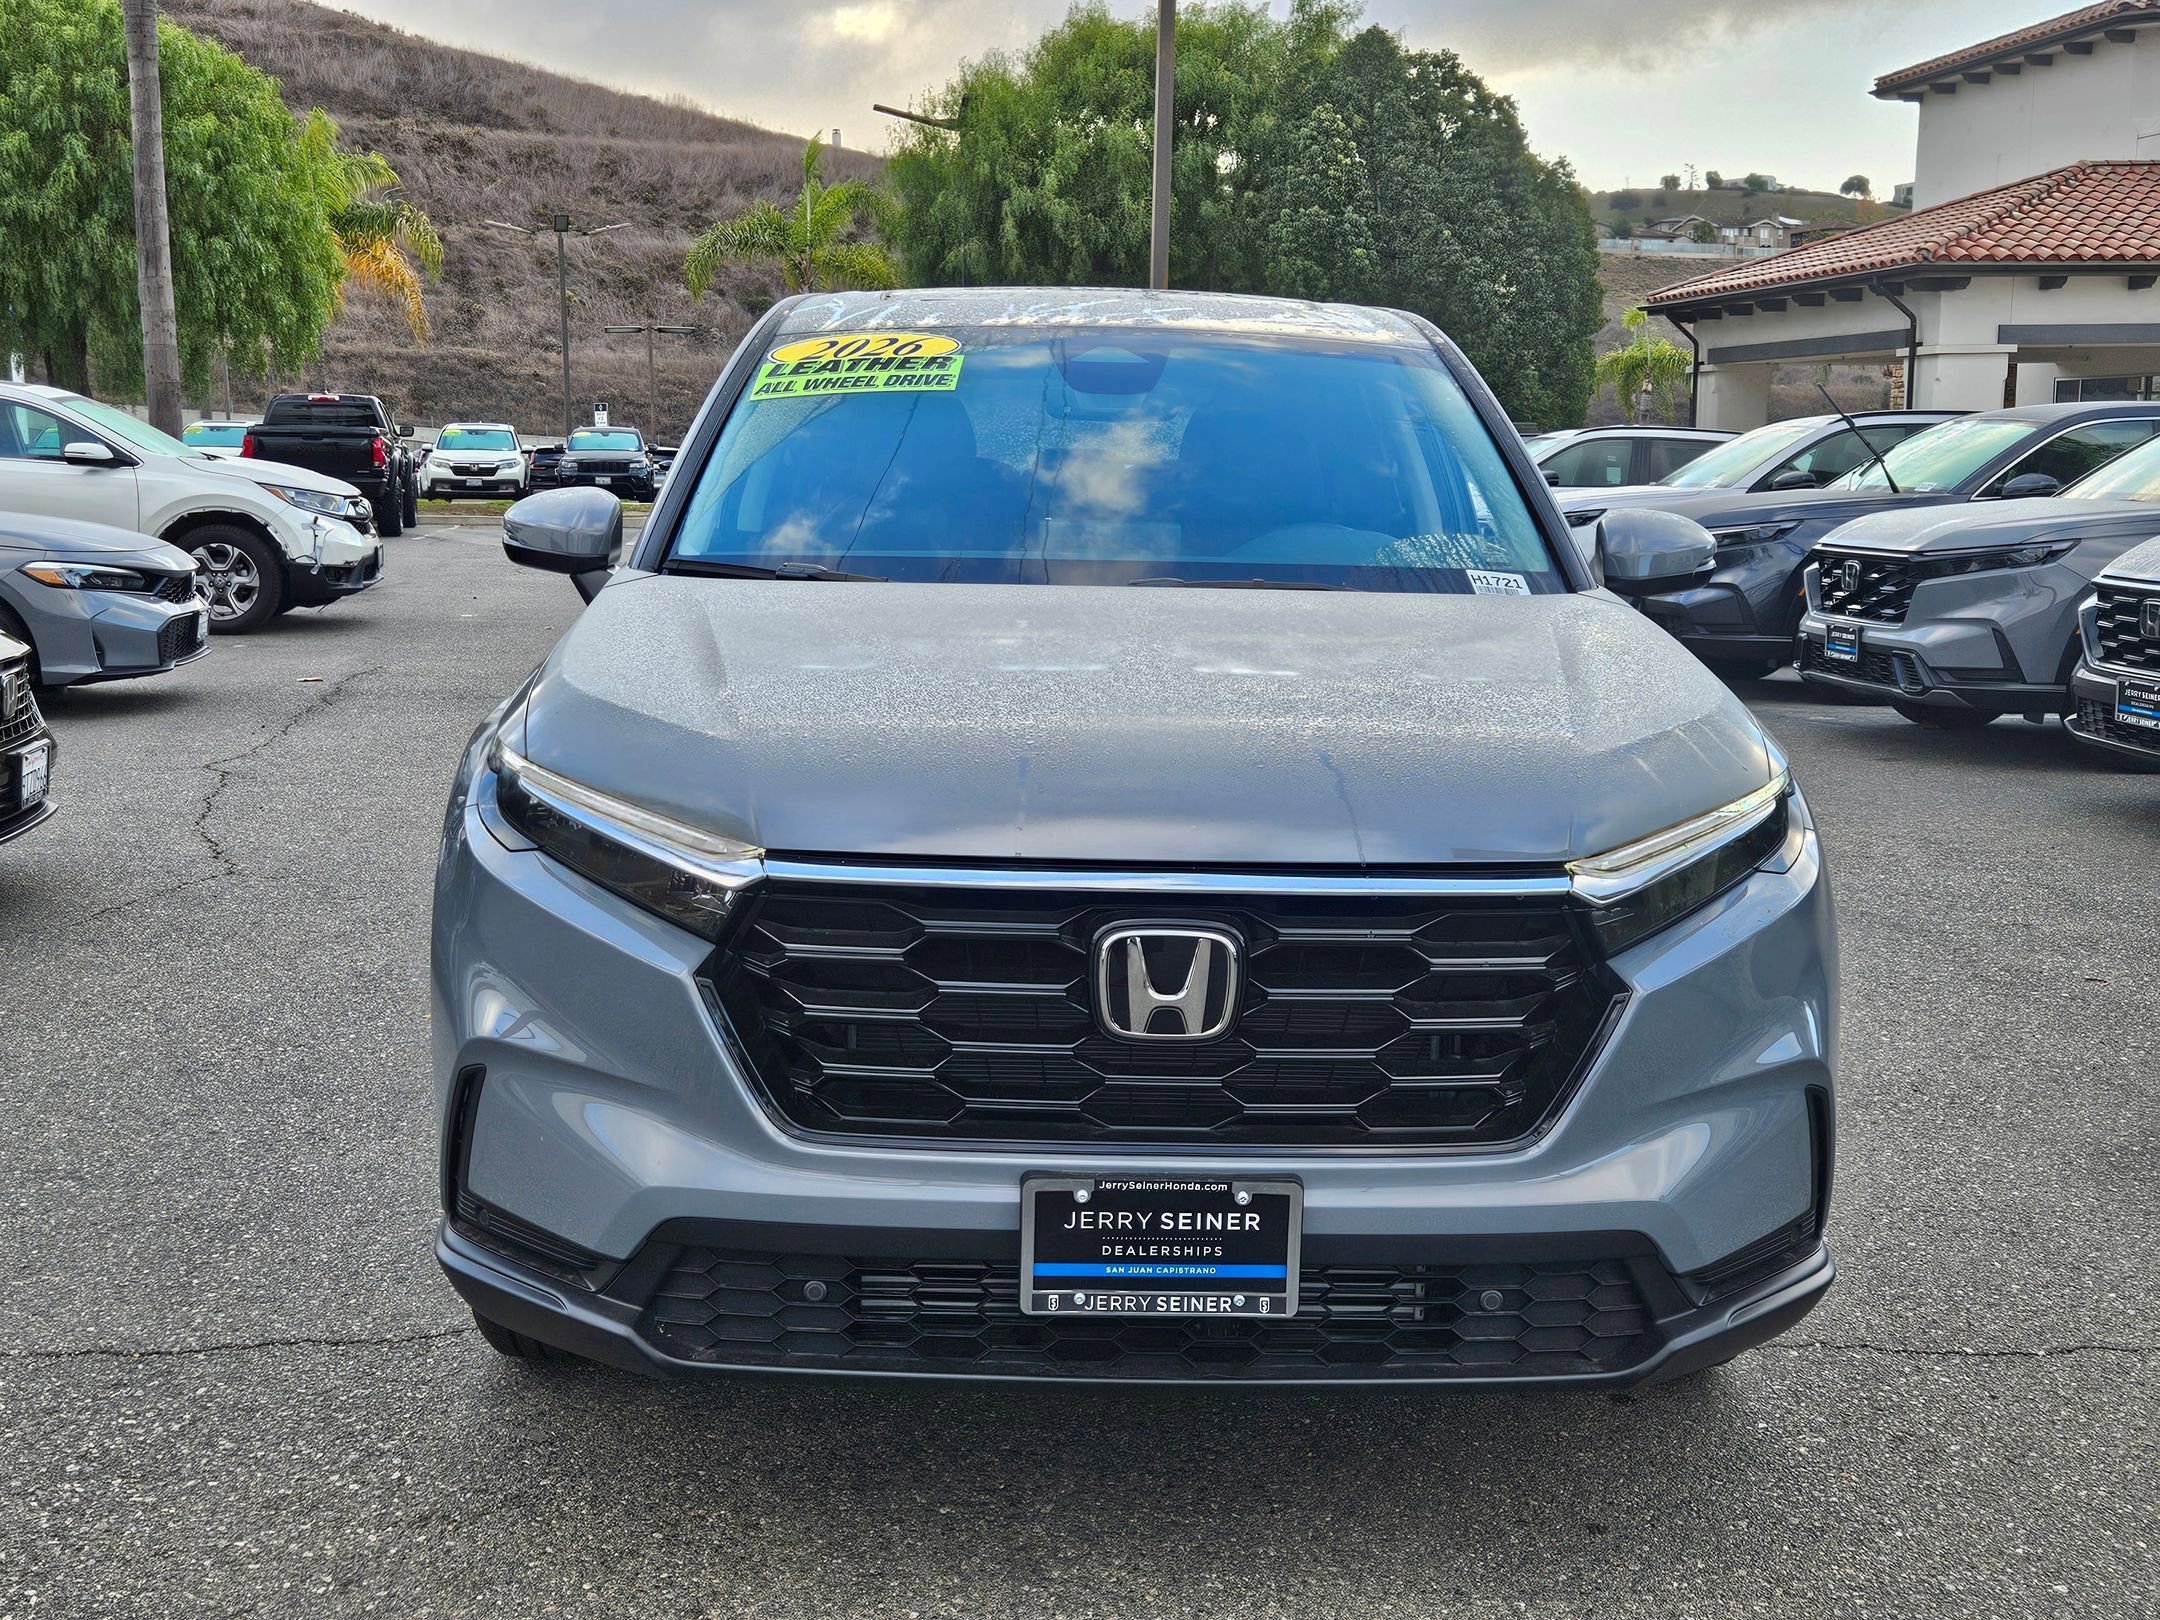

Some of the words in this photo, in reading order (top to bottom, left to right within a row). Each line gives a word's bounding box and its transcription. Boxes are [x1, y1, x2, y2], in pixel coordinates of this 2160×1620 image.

[800, 337, 934, 361] 2026
[765, 356, 954, 379] LEATHER
[754, 380, 798, 396] ALL
[803, 375, 878, 391] WHEEL
[883, 373, 954, 387] DRIVE
[1470, 574, 1523, 590] H1721
[2125, 689, 2141, 697] JERRY
[1099, 1180, 1228, 1192] JerrySeinerHonda.com
[1064, 1211, 1153, 1230] JERRY
[1160, 1212, 1261, 1231] SEINER
[1102, 1245, 1223, 1257] DEALERSHIPS
[1105, 1266, 1125, 1274] SAN
[1128, 1266, 1153, 1274] JUAN
[1156, 1266, 1217, 1275] CAPISTRANO
[1084, 1295, 1152, 1312] JERRY
[1156, 1296, 1232, 1313] SEINER
